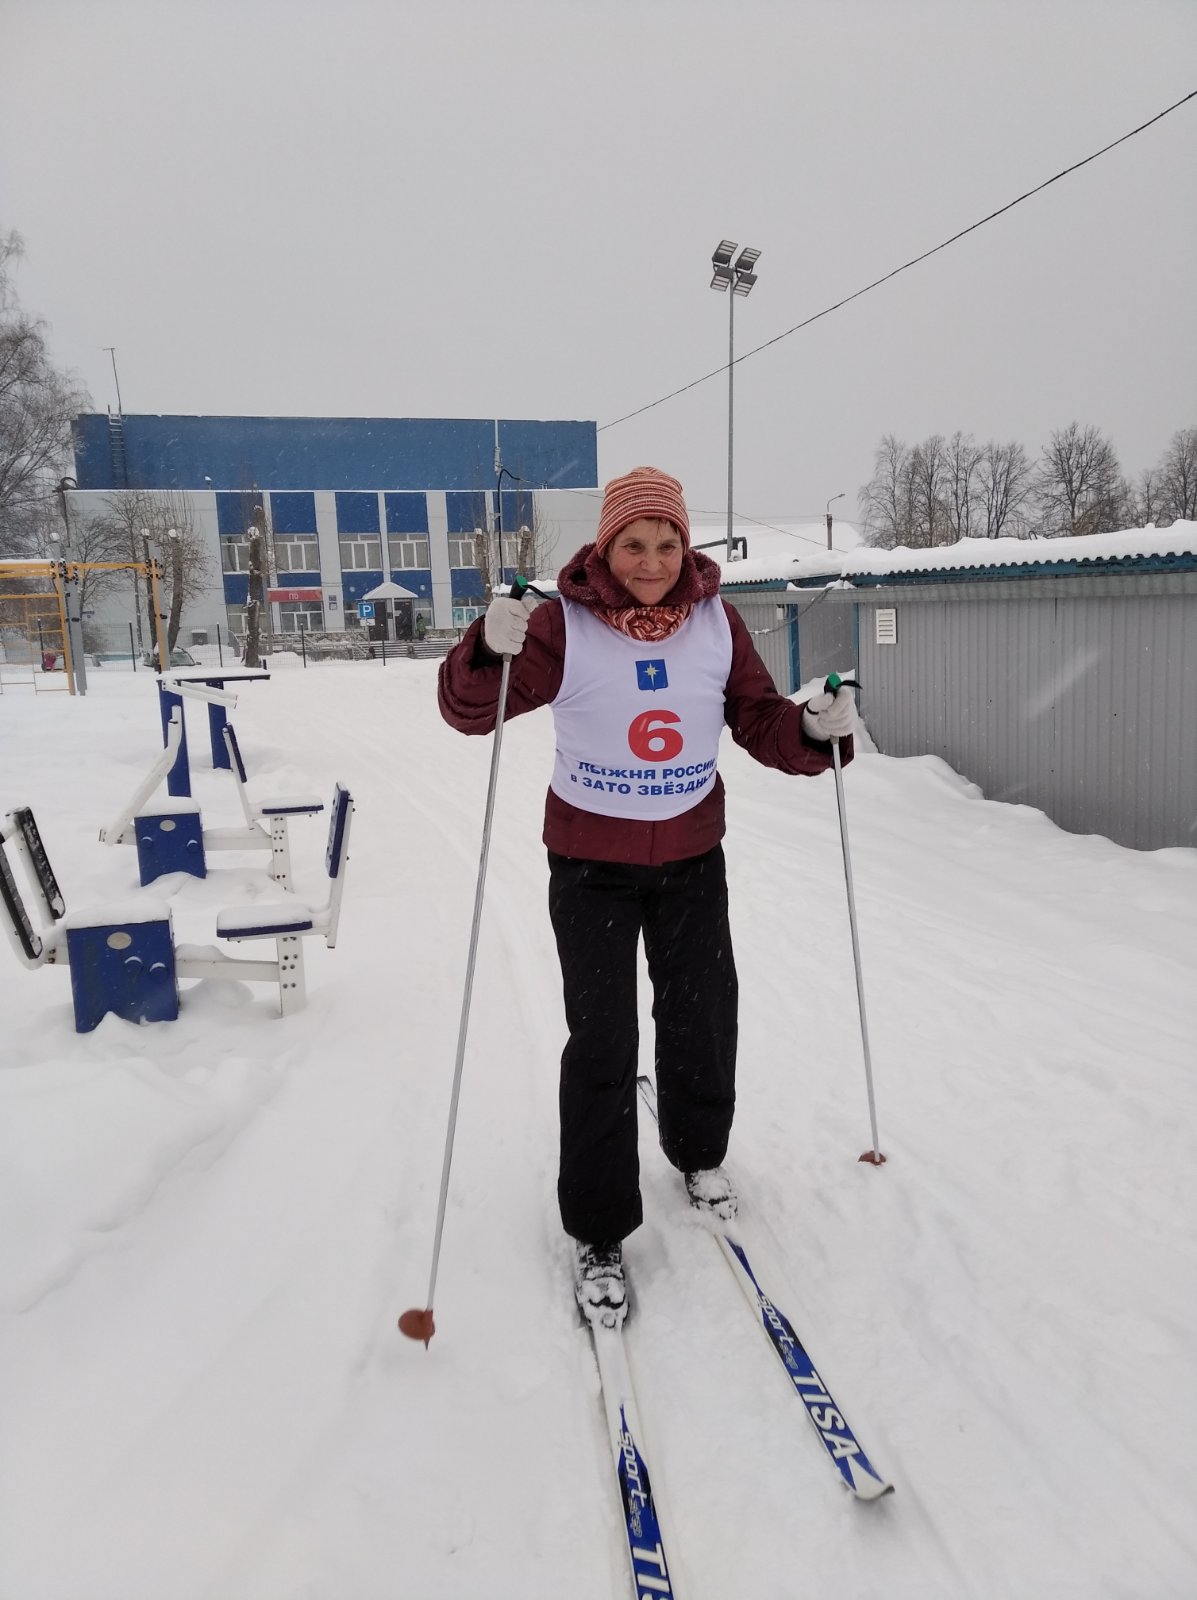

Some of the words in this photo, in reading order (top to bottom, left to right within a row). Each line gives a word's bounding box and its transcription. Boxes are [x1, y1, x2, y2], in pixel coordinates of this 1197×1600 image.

[362, 605, 372, 617] P
[627, 709, 684, 763] 6
[582, 777, 631, 795] ЗАТО
[637, 768, 715, 796] ЗВЁЗДНЫ
[757, 1294, 795, 1348] sport
[793, 1370, 862, 1459] TISA
[618, 1429, 648, 1508] sport
[632, 1541, 671, 1600] TI
